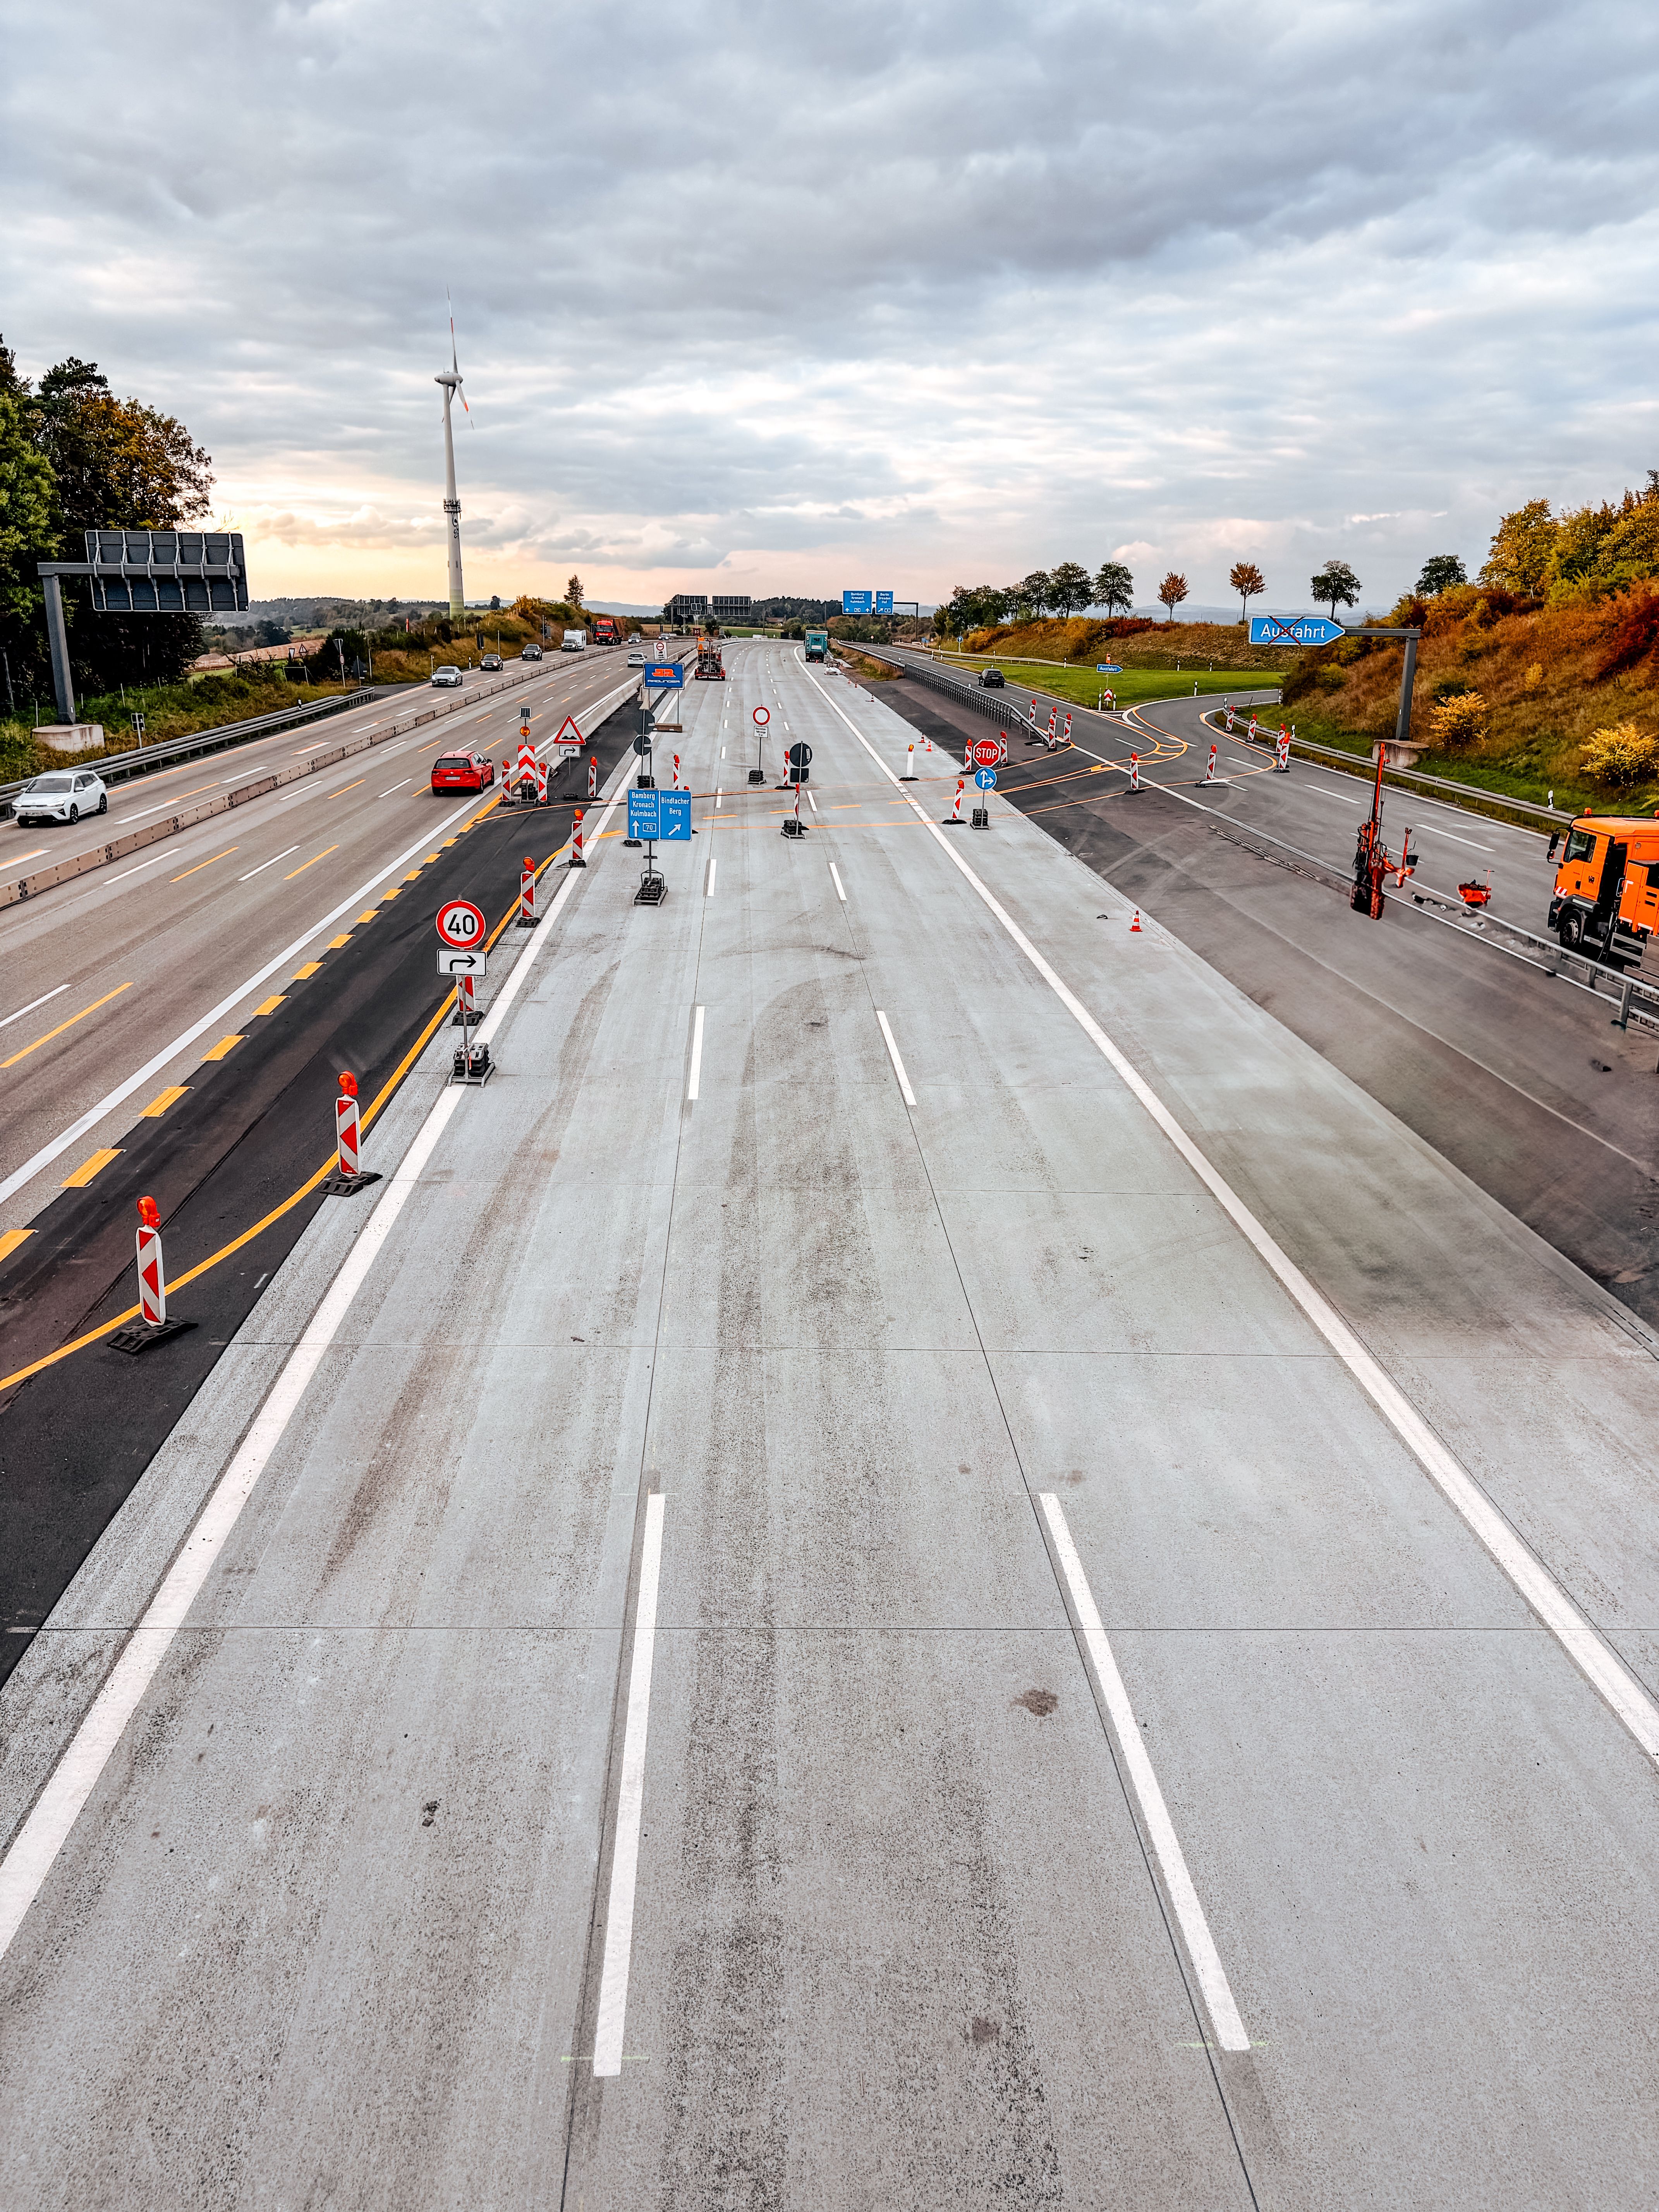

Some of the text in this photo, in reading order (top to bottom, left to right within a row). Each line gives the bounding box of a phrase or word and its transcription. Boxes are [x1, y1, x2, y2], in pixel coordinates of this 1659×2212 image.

[1261, 623, 1326, 638] Ausfahrt
[976, 747, 998, 759] STOP
[632, 792, 655, 800] Bamberg
[669, 807, 682, 816] Berg
[448, 914, 475, 935] 40
